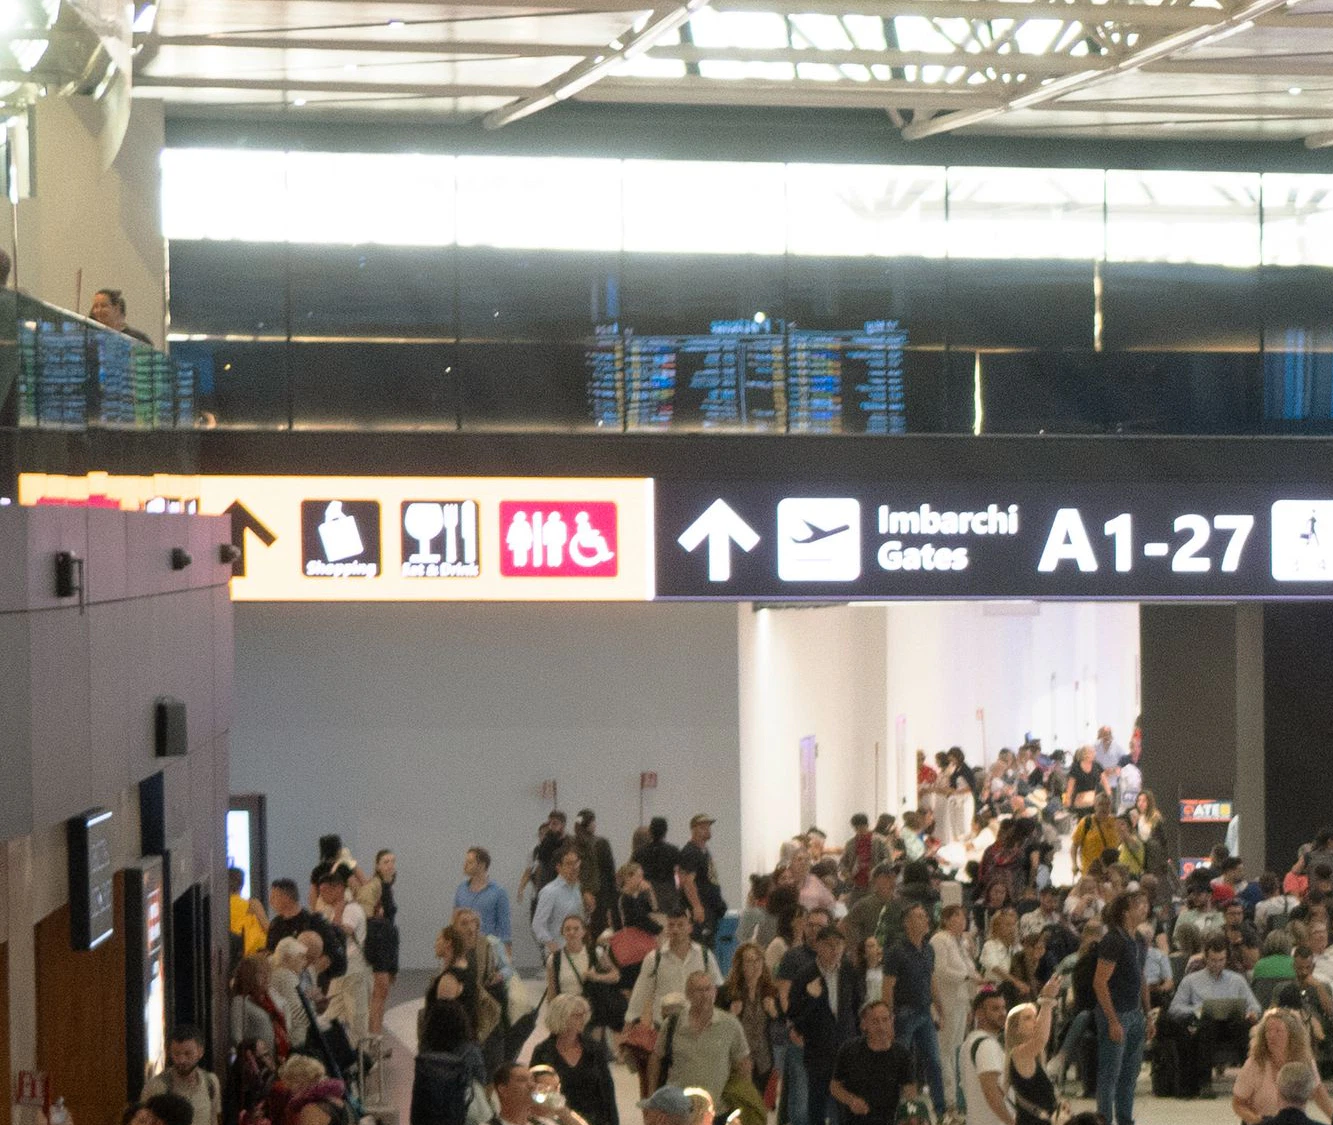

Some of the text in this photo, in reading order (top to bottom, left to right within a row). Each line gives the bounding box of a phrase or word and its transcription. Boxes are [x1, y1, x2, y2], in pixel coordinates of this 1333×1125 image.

[879, 505, 1018, 536] Imbarchi
[1037, 507, 1255, 574] A1-27
[306, 561, 377, 577] Shopping
[877, 542, 968, 572] Gates
